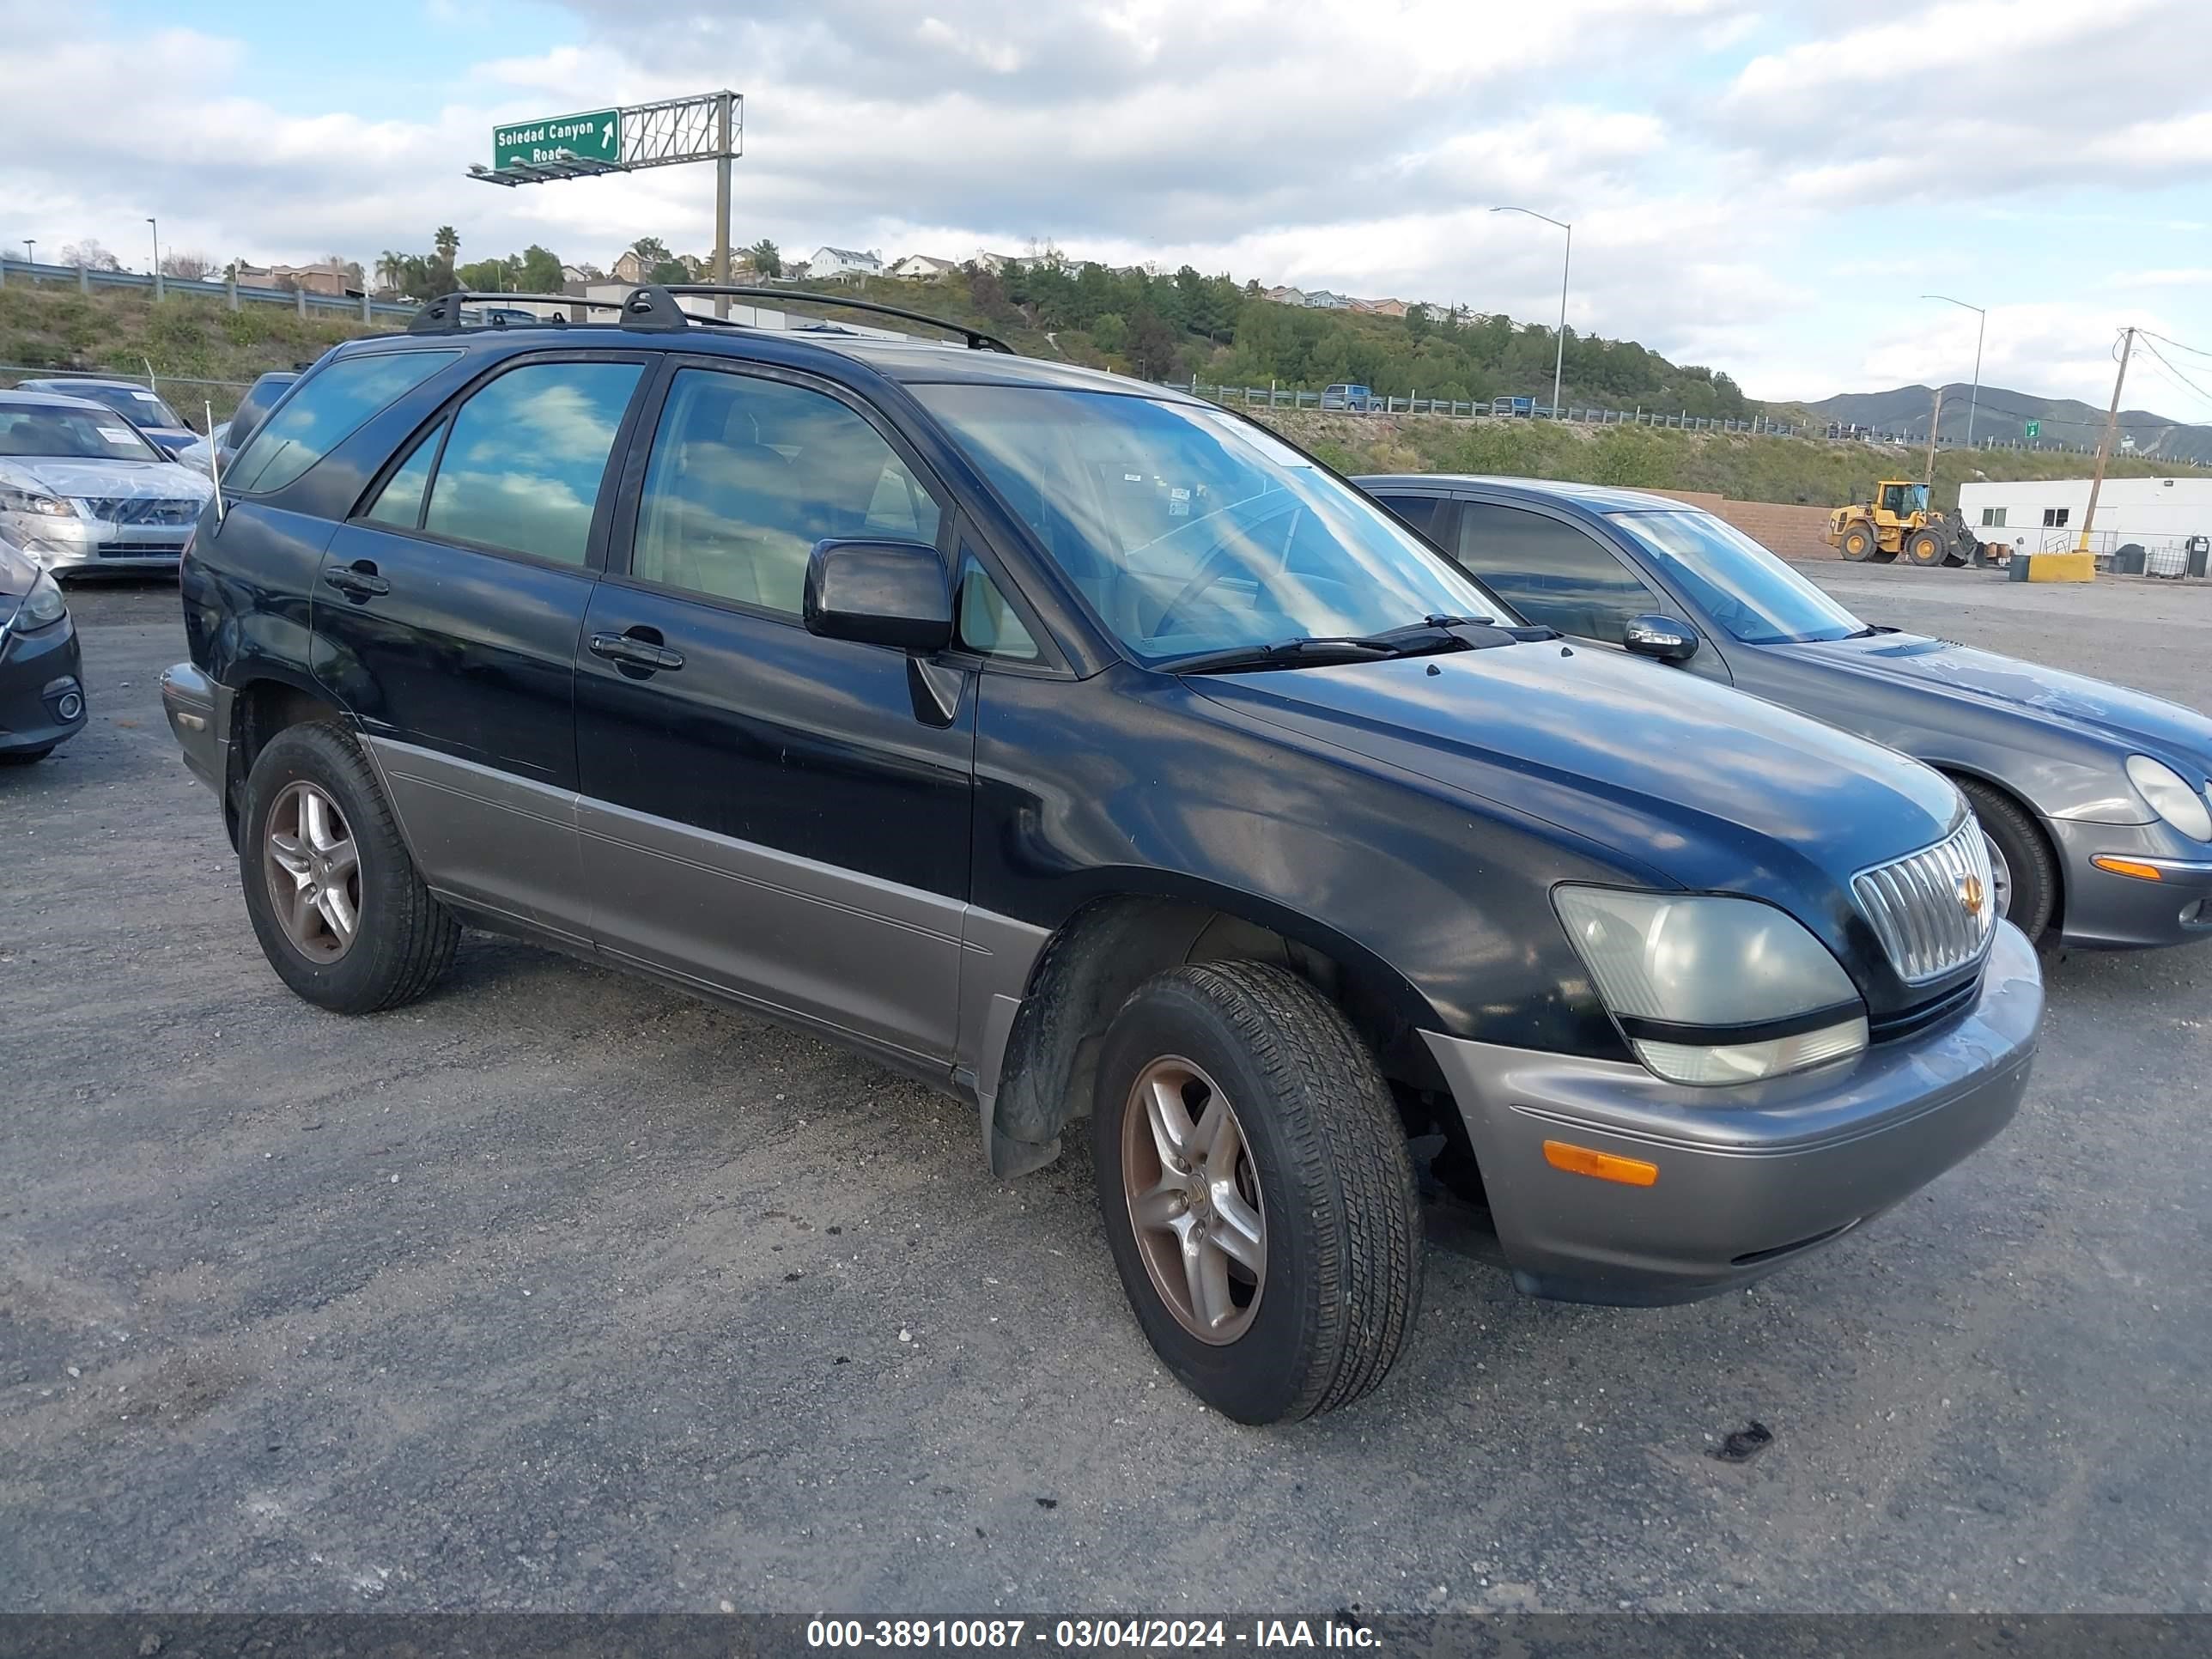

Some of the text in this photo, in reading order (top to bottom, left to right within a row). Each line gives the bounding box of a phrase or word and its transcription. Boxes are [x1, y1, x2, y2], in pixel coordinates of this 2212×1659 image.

[498, 122, 593, 147] Soledad Canyon
[533, 145, 562, 162] Road
